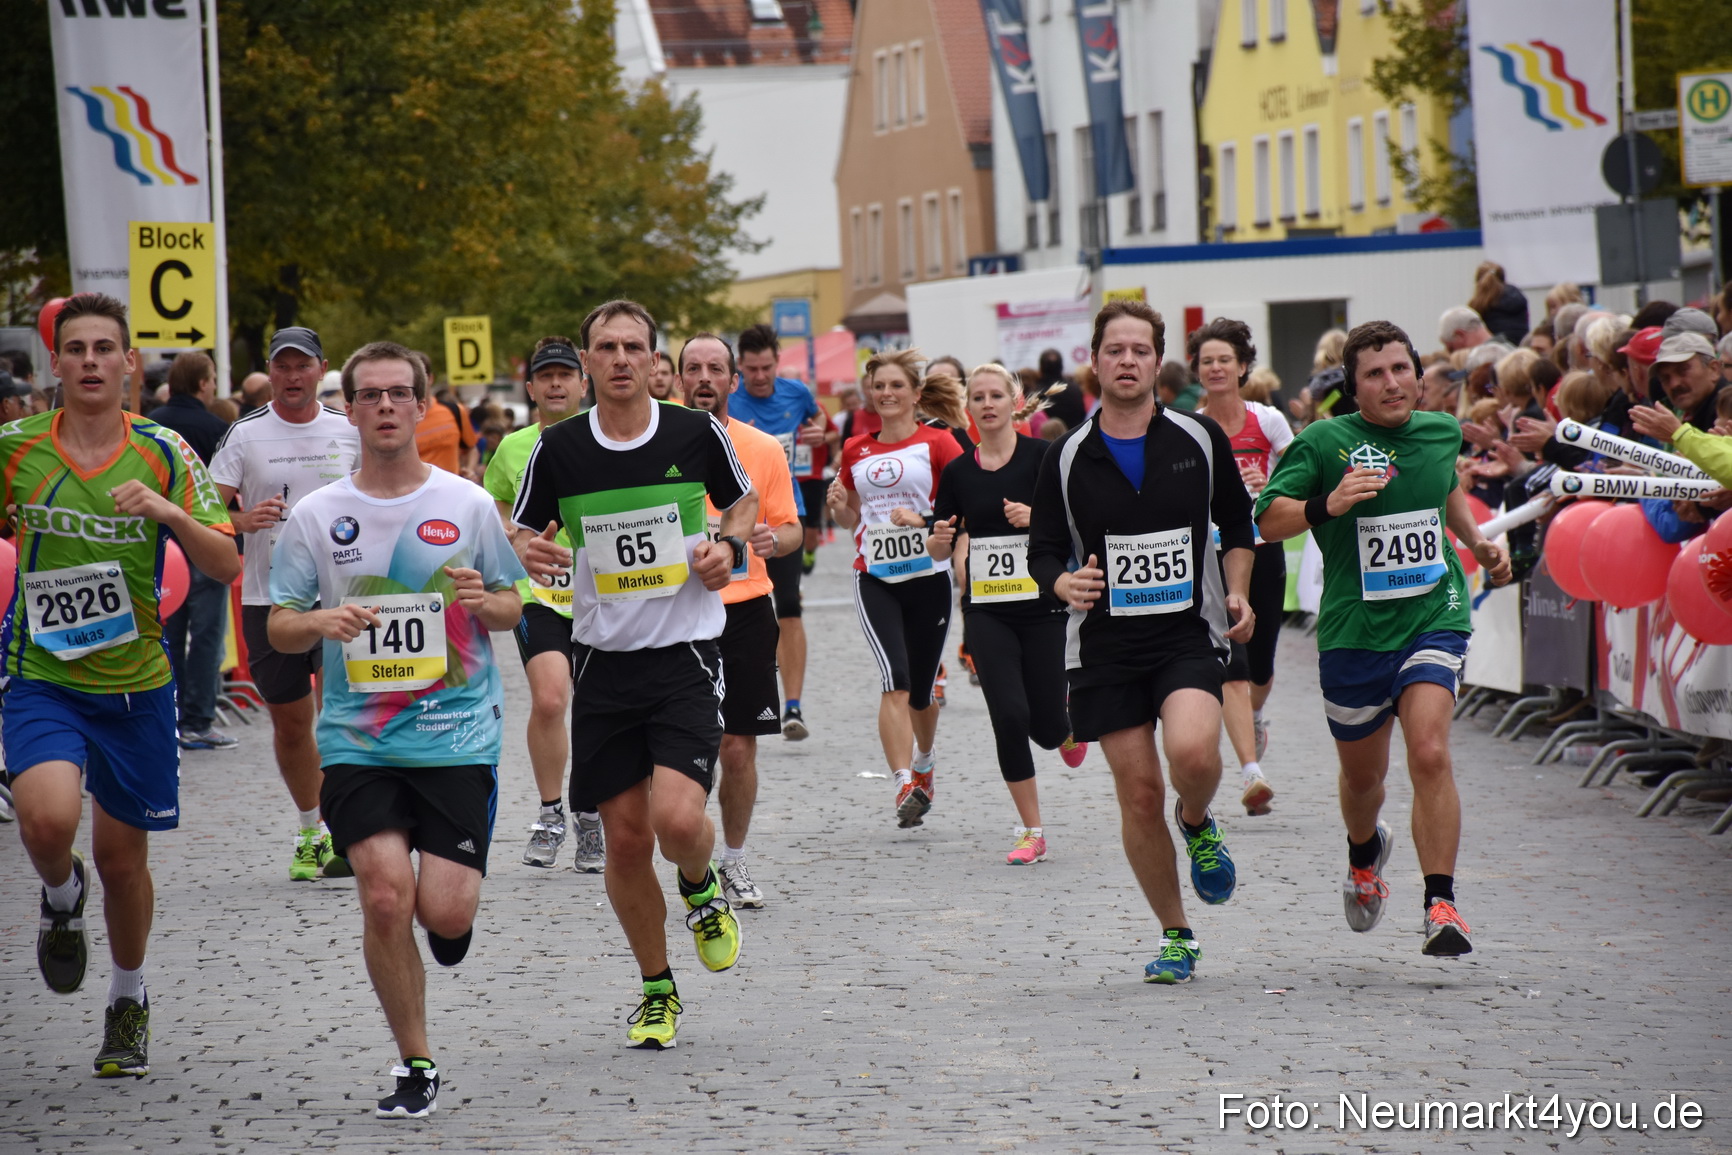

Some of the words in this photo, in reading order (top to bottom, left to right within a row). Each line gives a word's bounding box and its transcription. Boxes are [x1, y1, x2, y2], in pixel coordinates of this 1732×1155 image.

[139, 227, 204, 249] Block
[151, 259, 193, 321] C
[451, 321, 484, 333] Block
[458, 338, 480, 369] D
[268, 455, 296, 464] weidinger
[1593, 478, 1638, 495] BMW
[22, 503, 146, 544] BOCK
[585, 523, 616, 534] PARTL
[617, 516, 664, 531] Neumarkt
[1360, 524, 1388, 534] PARTL
[1388, 519, 1428, 531] Neumarkt
[422, 525, 456, 540] Hervis
[615, 531, 657, 567] 65
[872, 532, 925, 561] 2003
[989, 542, 1022, 551] Neumarkt
[1108, 542, 1136, 551] PARTL
[1137, 538, 1179, 550] Neumarkt
[1367, 530, 1437, 568] 2498
[332, 548, 362, 560] PARTL
[334, 555, 363, 566] Neumarkt
[888, 562, 912, 575] Steffi
[987, 552, 1015, 577] 29
[1116, 549, 1187, 585] 2355
[25, 580, 53, 591] PARTL
[54, 573, 104, 588] Neumarkt
[617, 574, 664, 590] Markus
[1387, 572, 1426, 587] Rainer
[983, 582, 1023, 594] Christina
[36, 582, 121, 628] 2826
[1125, 589, 1183, 605] Sebastian
[377, 604, 426, 614] Neumarkt
[66, 628, 105, 647] Lukas
[363, 618, 425, 655] 140
[372, 663, 415, 679] Stefan
[416, 711, 472, 721] Neumarkter
[415, 721, 462, 732] Stadtlauf
[145, 806, 176, 818] hummel
